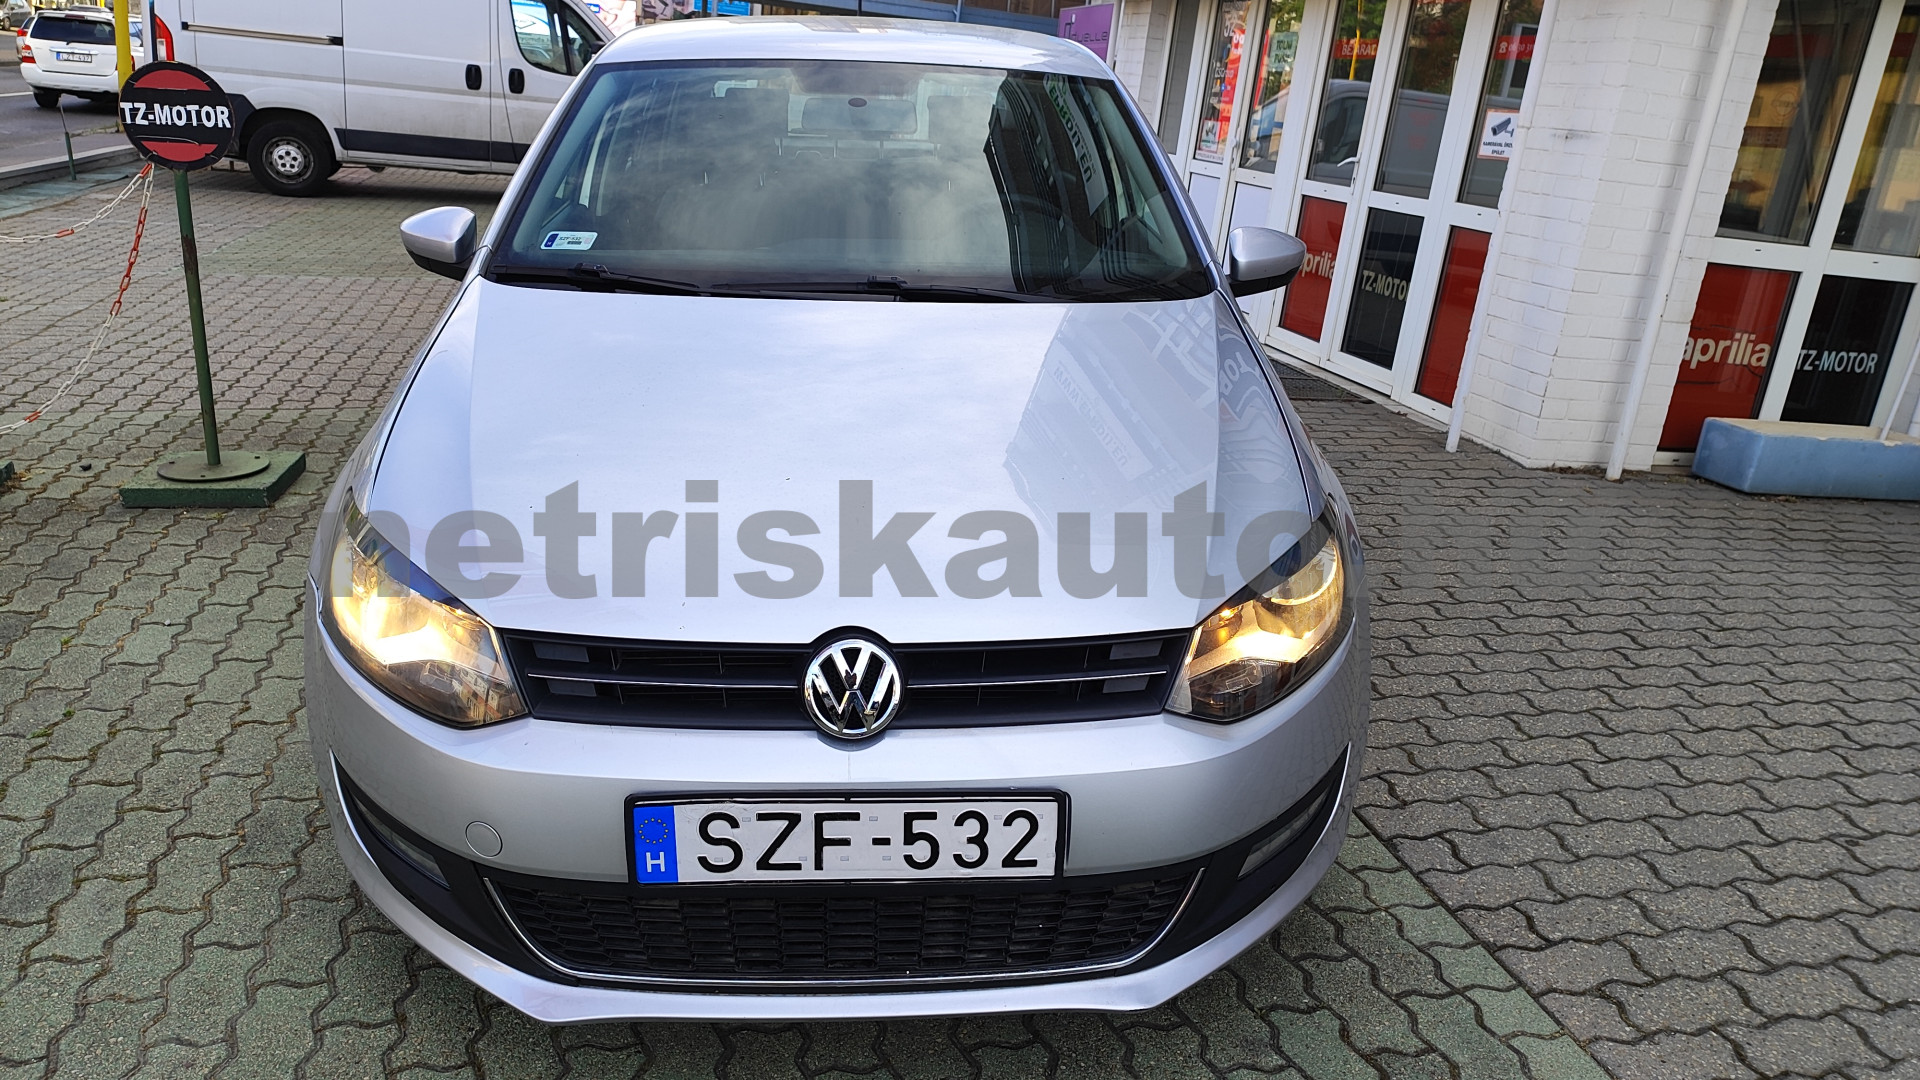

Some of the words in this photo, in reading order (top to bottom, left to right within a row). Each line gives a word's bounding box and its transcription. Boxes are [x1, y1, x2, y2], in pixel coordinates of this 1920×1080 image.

[119, 101, 232, 129] TZ-MOTOR
[1682, 332, 1771, 370] aprilia
[1796, 348, 1878, 375] TZ-MOTOR
[696, 809, 1040, 874] SZF-532
[645, 851, 666, 873] H
